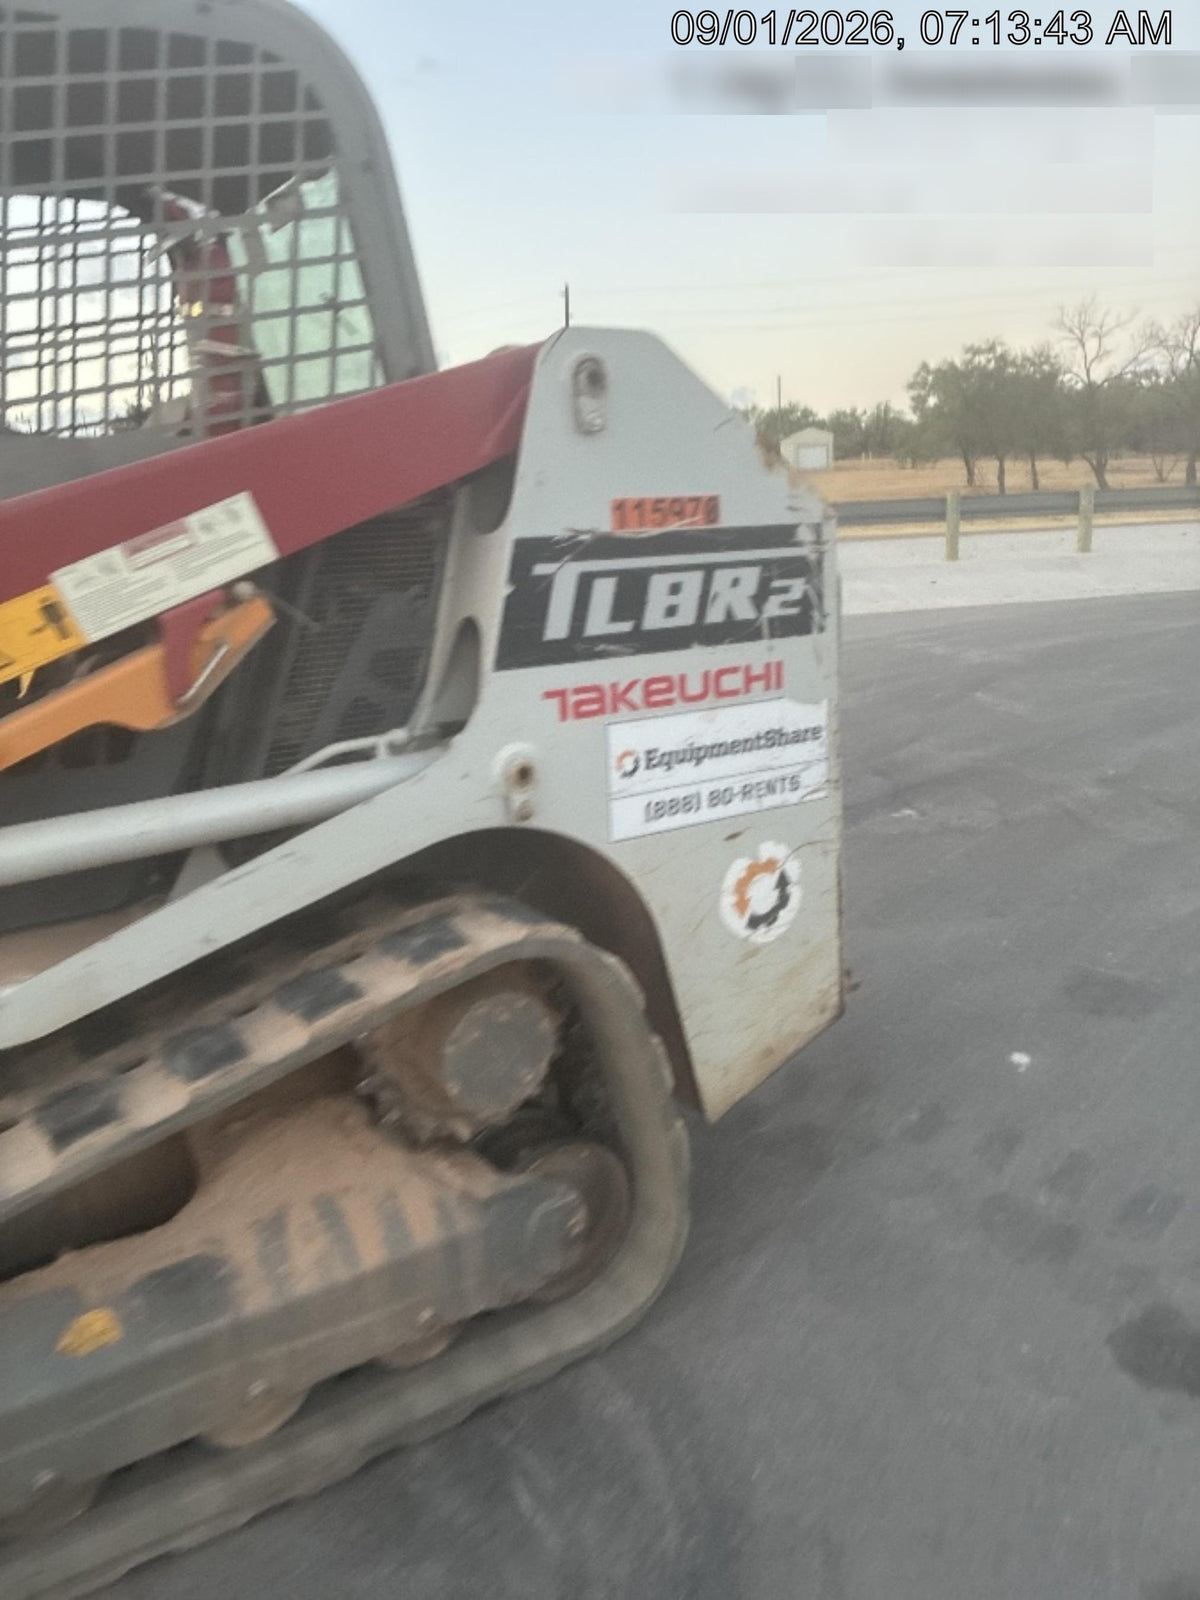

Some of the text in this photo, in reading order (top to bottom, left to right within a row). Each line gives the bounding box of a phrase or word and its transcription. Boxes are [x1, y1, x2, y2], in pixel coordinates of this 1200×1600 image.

[644, 725, 824, 771] EquipmentShare
[644, 774, 801, 823] (888) 80-RENTS
